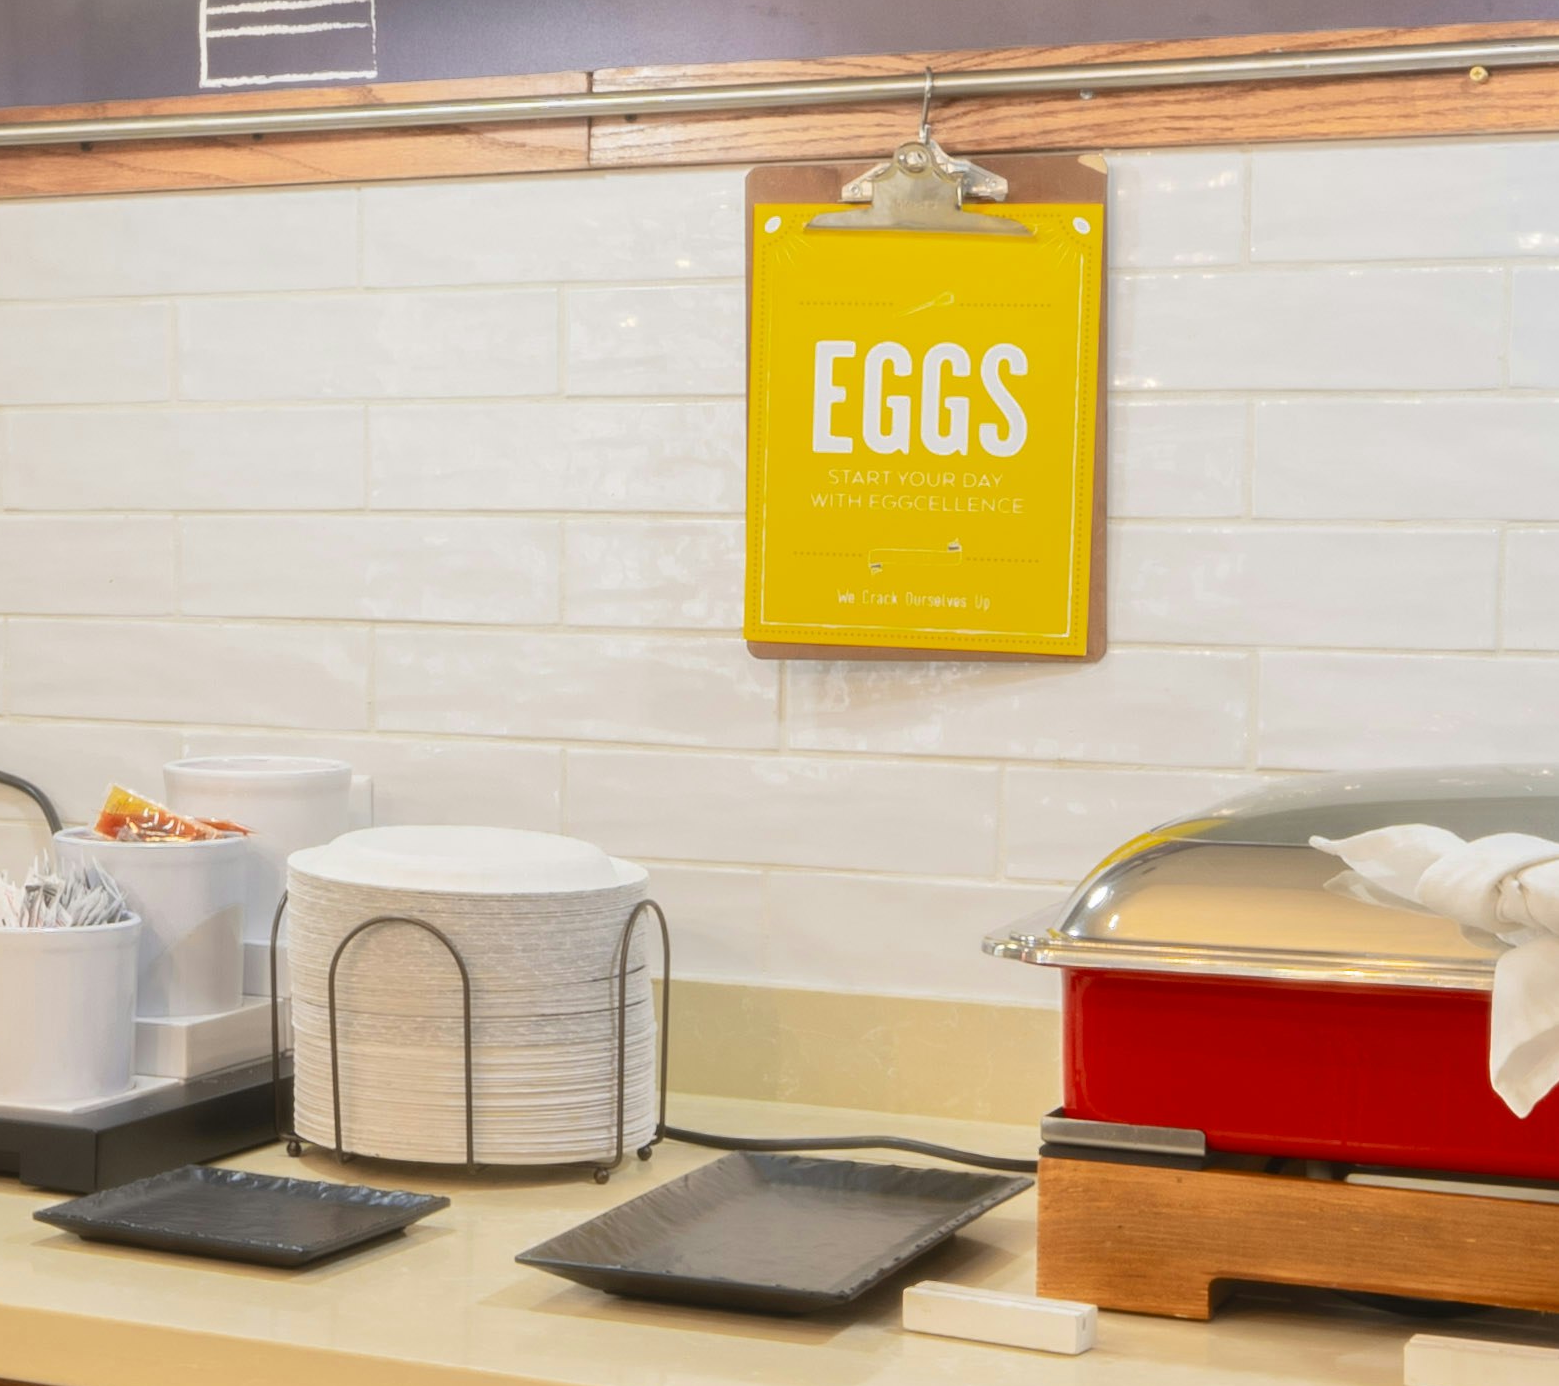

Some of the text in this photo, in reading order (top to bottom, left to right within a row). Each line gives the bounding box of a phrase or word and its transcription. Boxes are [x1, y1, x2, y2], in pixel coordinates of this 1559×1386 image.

[811, 339, 1029, 458] EGGS
[828, 469, 1004, 489] START YOUR DAY
[810, 492, 1026, 515] WITH EGGCELLENCE
[836, 589, 991, 612] We Crack Ourselves Up
